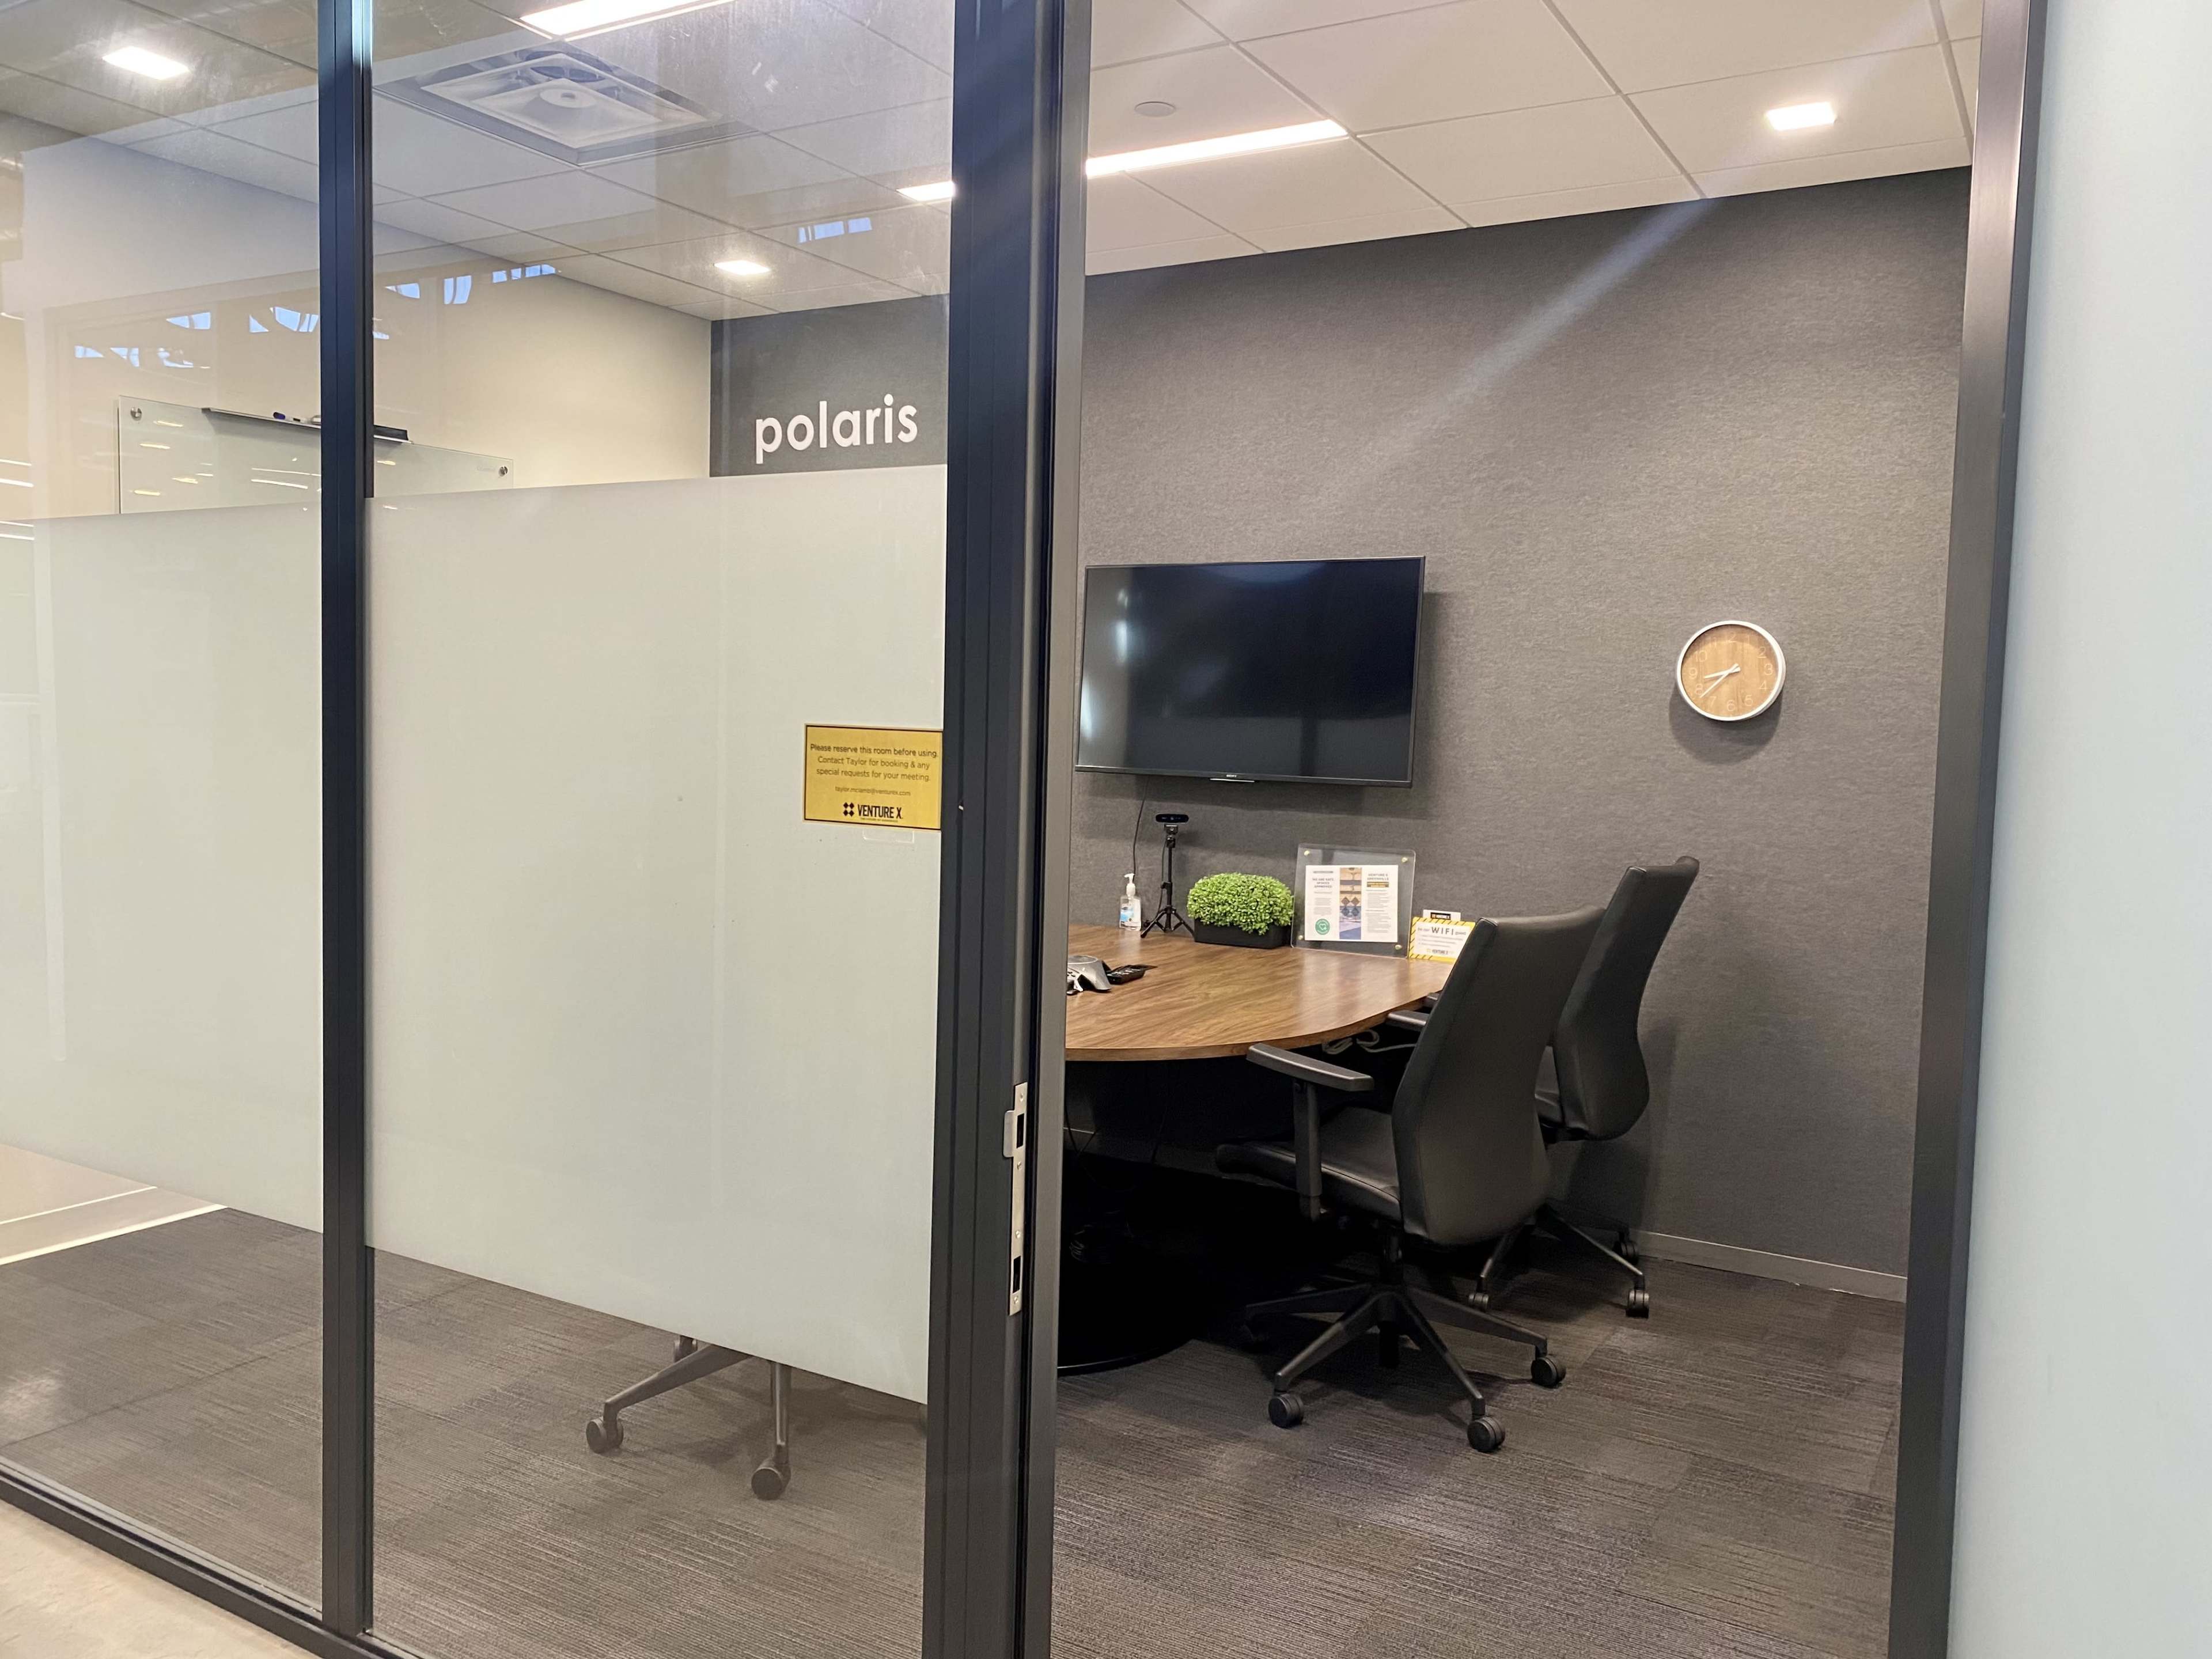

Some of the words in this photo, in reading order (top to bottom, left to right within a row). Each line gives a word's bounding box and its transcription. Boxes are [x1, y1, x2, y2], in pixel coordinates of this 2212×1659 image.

[756, 393, 918, 464] polaris
[1694, 650, 1707, 662] 10
[1758, 646, 1767, 658] 2
[1689, 667, 1698, 680] 9
[1764, 663, 1774, 676] 3
[1696, 683, 1705, 695] 8
[1759, 681, 1767, 691] 4
[1708, 696, 1717, 707] 7
[1727, 700, 1736, 711] 6
[1745, 695, 1753, 706] 5
[810, 744, 831, 752] Please
[893, 748, 916, 756] before
[818, 756, 844, 764] Contact
[846, 757, 867, 766] Taylor
[869, 758, 878, 766] for
[880, 760, 908, 769] booking
[917, 762, 930, 770] any
[857, 804, 894, 819] VENTURE
[896, 807, 902, 820] X
[1431, 926, 1454, 935] WIFI
